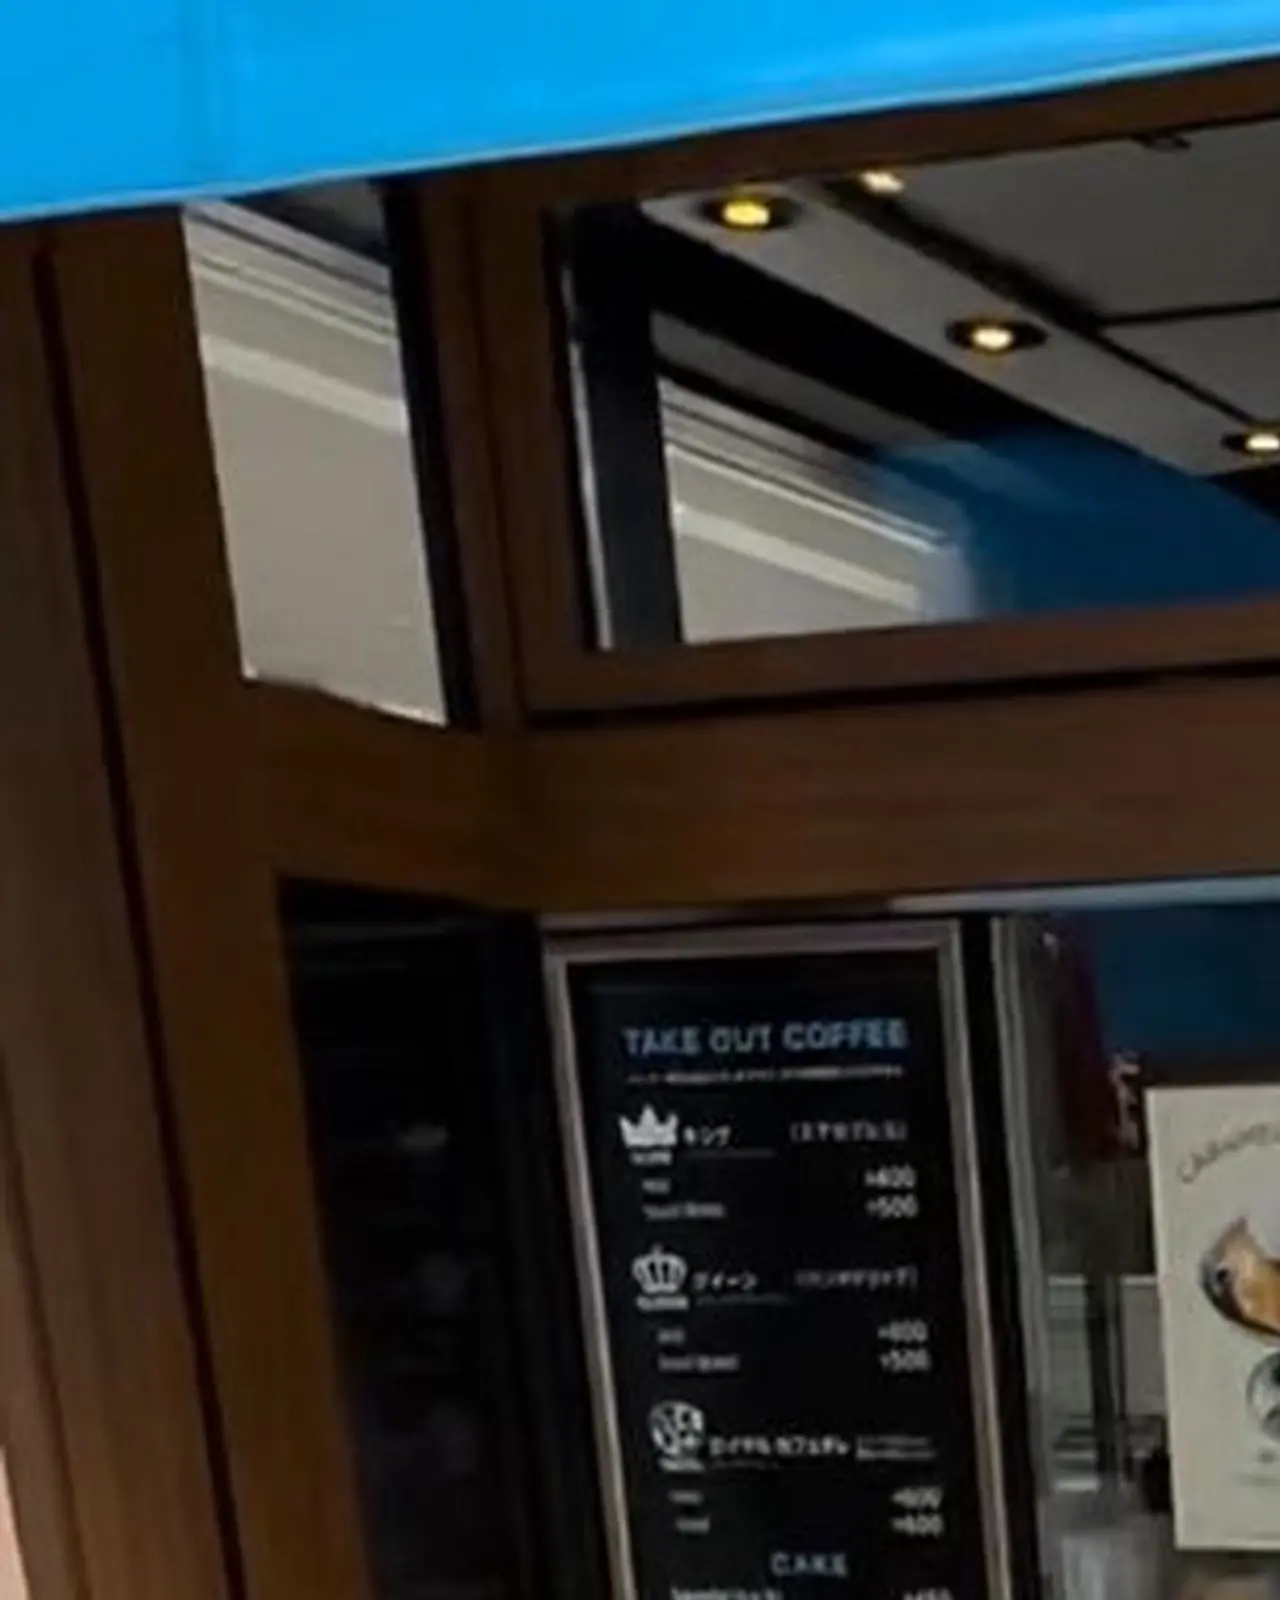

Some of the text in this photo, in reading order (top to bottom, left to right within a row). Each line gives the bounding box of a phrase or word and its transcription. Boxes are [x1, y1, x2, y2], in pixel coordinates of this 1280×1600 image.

[622, 1016, 908, 1056] TAKE OUT COFFEE
[770, 1550, 848, 1579] CAKE
